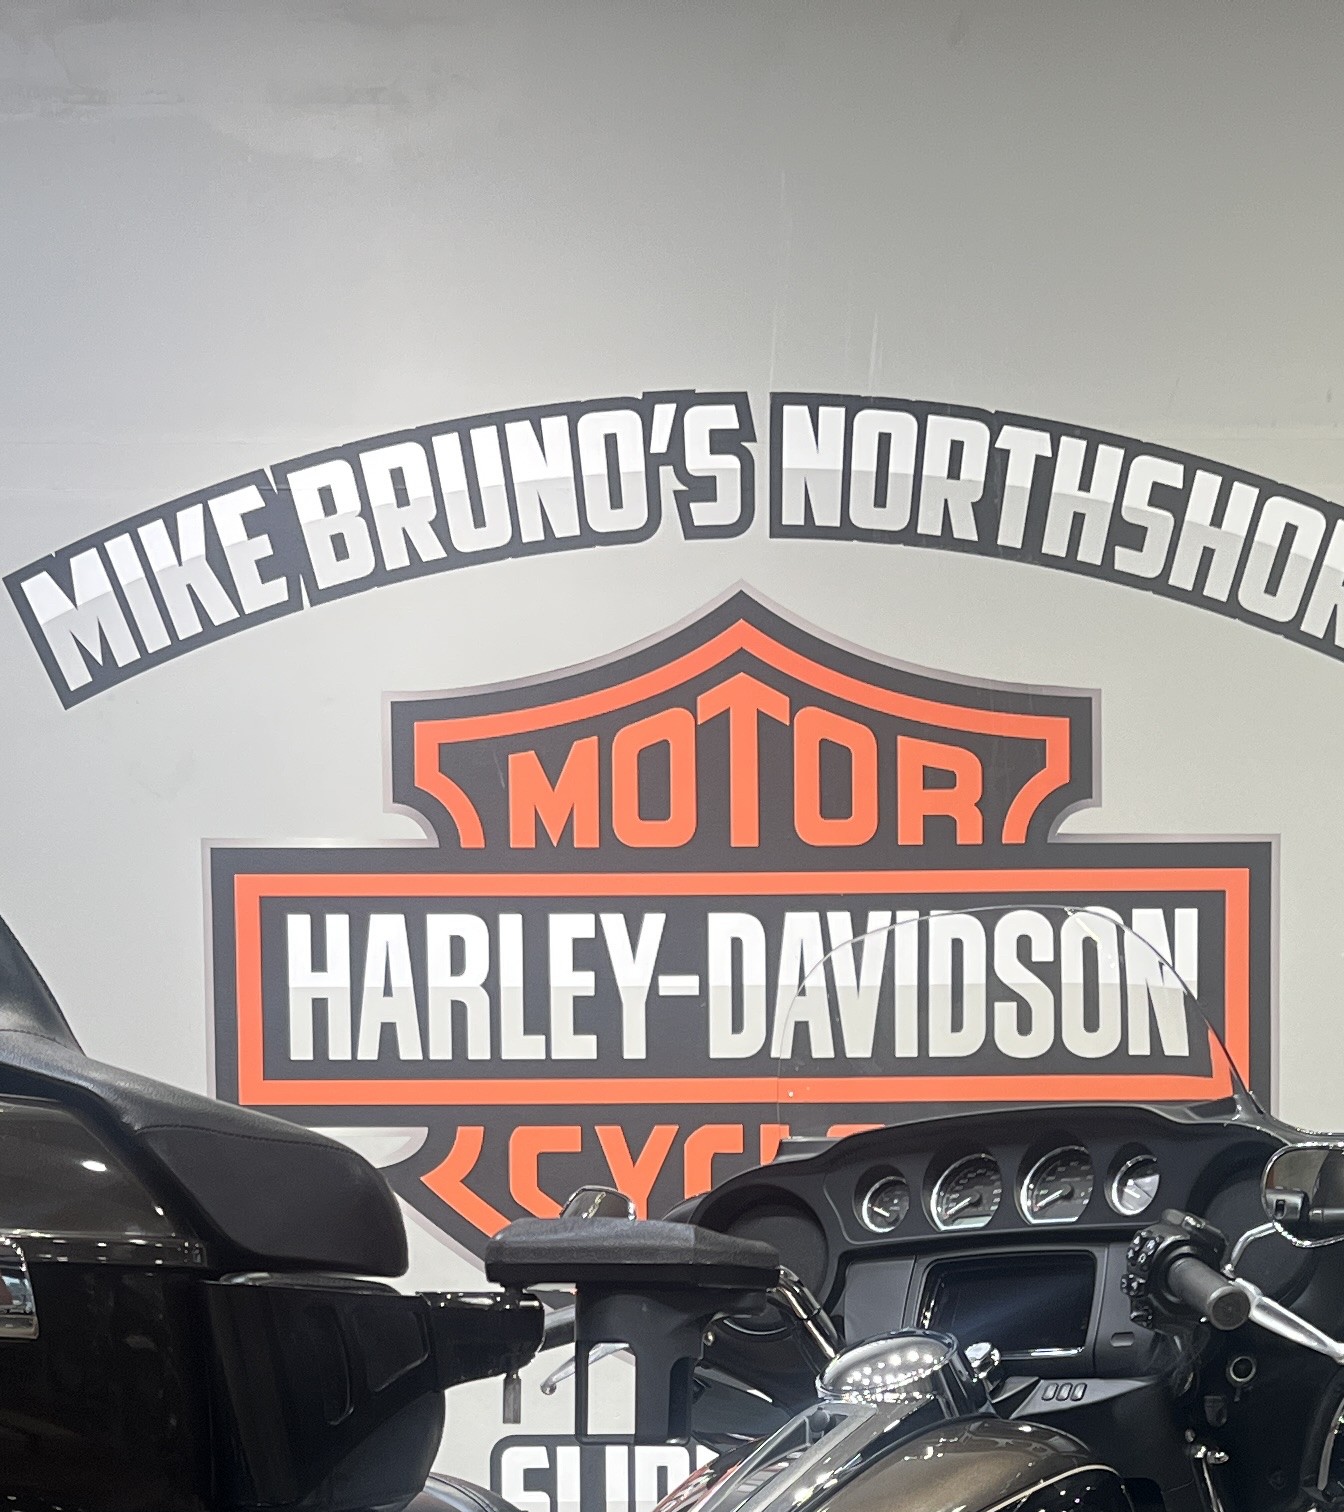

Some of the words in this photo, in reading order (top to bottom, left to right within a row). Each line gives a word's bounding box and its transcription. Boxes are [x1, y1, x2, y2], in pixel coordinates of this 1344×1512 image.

[20, 485, 289, 692] MIKE
[286, 403, 741, 591] BRUNO'S
[508, 672, 983, 848] MOTOR
[287, 906, 1199, 1061] HARLEY-DAVIDSON
[509, 1124, 886, 1220] CYC
